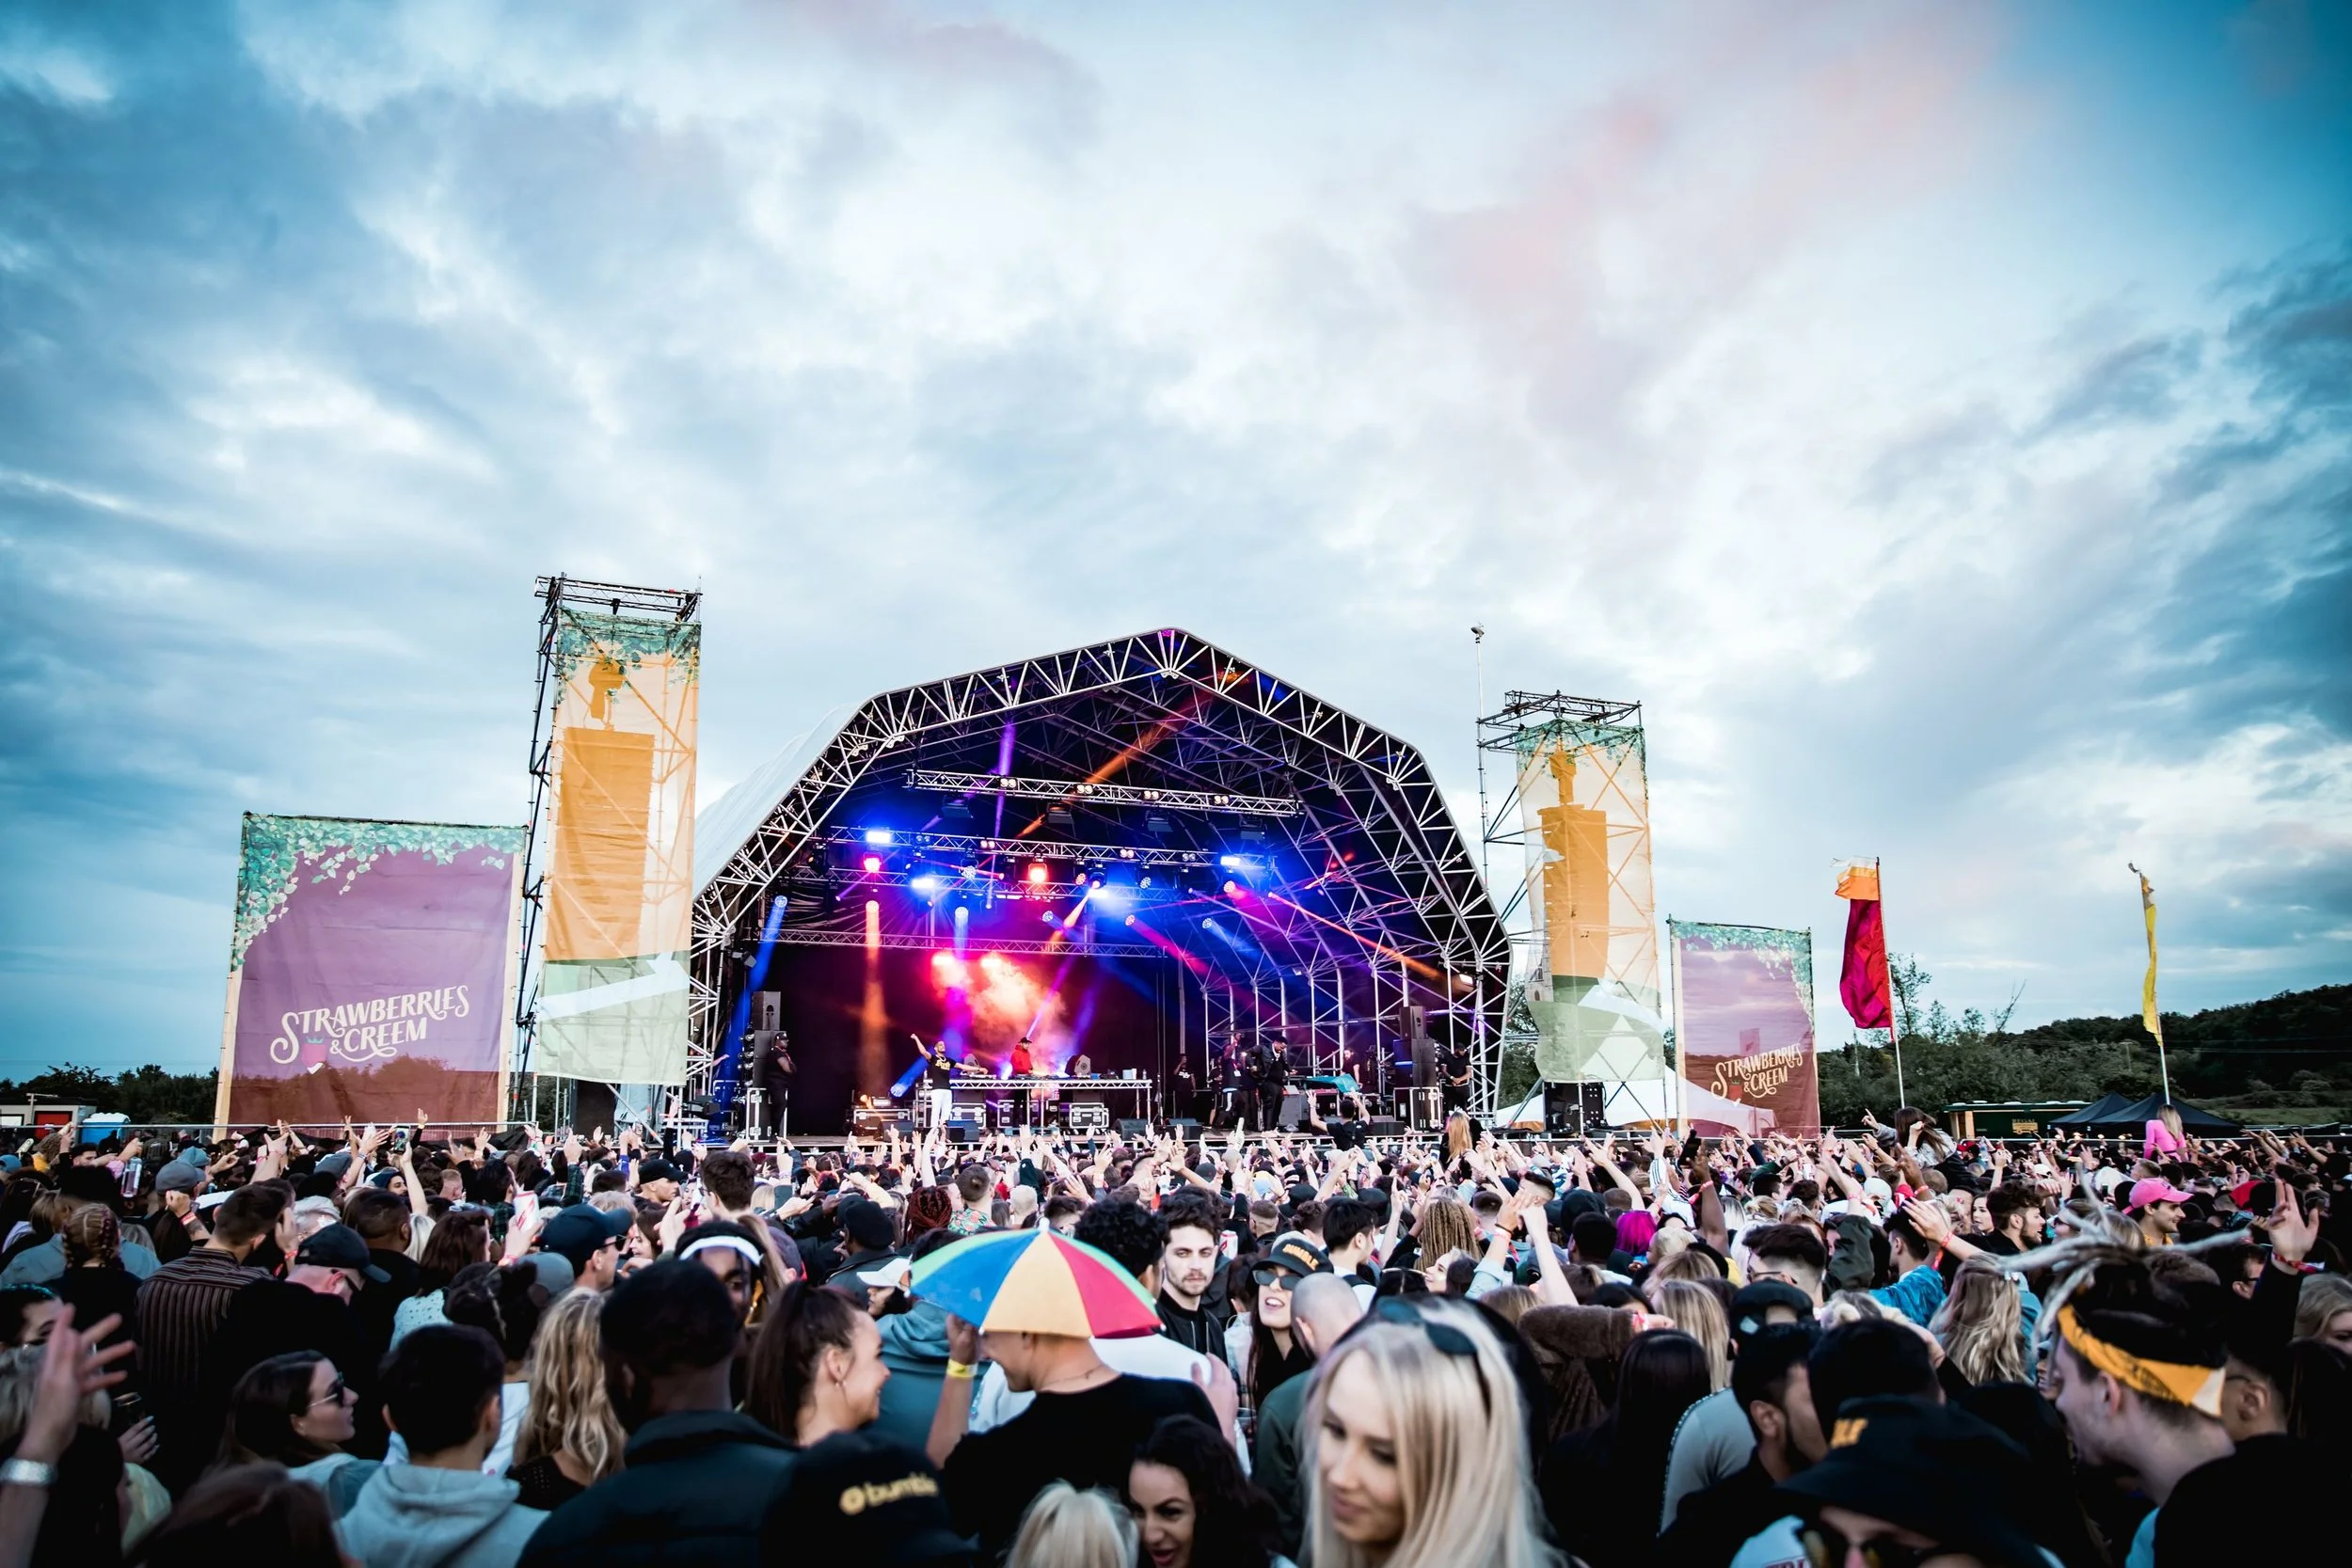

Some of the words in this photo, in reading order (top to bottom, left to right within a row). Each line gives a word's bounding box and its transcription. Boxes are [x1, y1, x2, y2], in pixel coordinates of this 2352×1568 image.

[270, 985, 469, 1064] STRAWBERRIES
[343, 1017, 427, 1062] CREEM
[1710, 1043, 1803, 1100] STRAWBERRIES
[1751, 1066, 1788, 1098] CREEM
